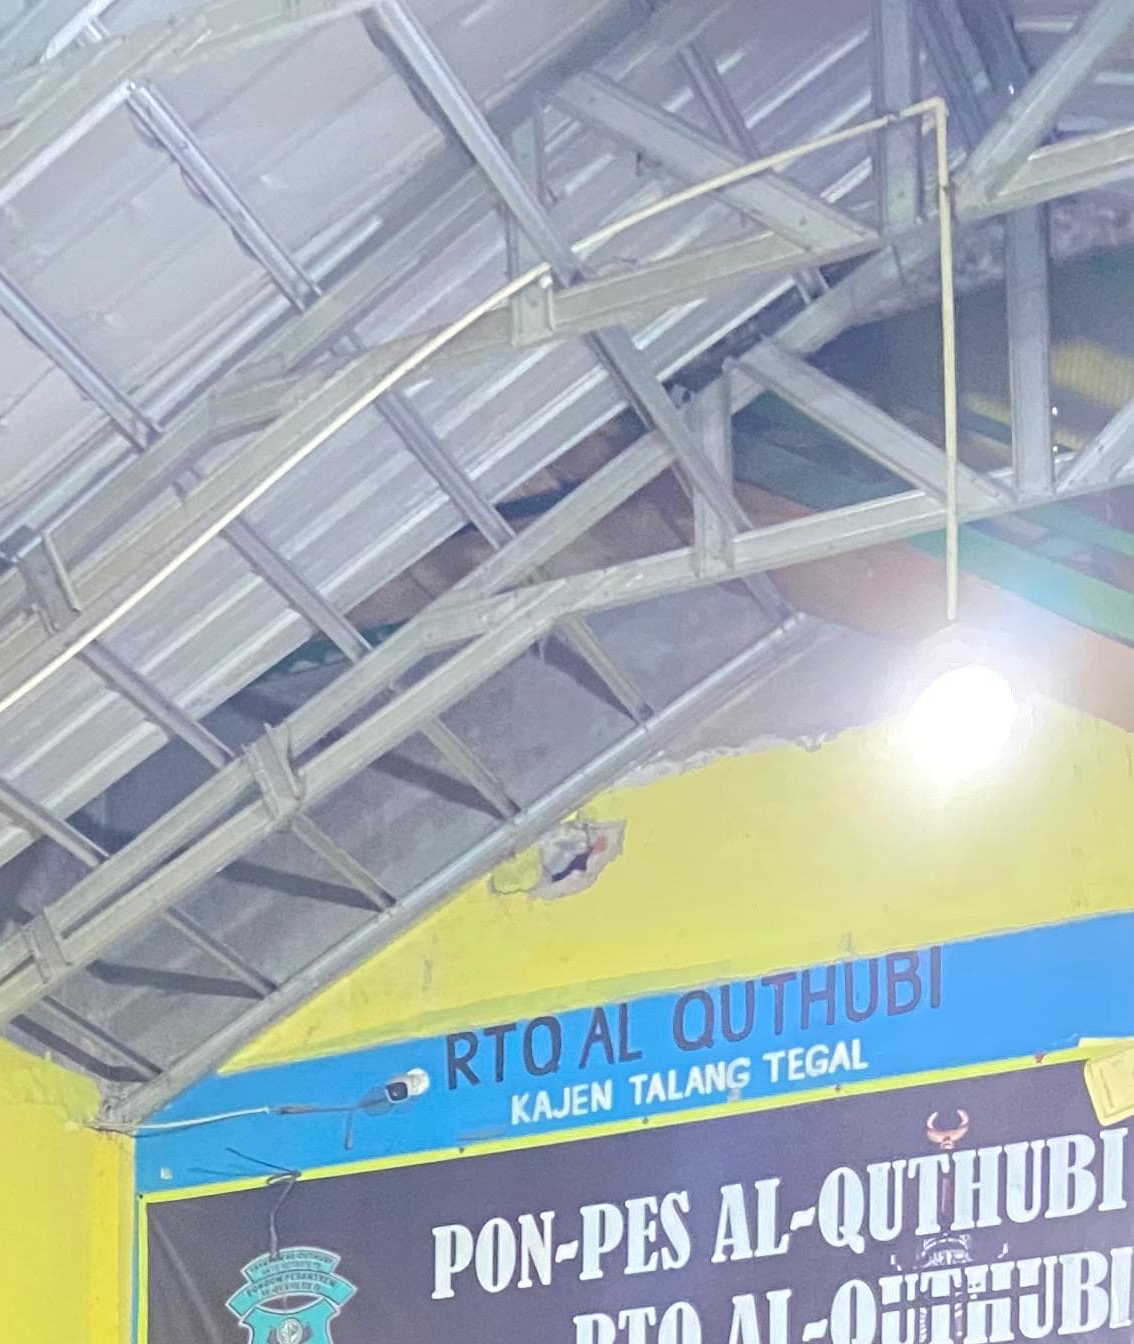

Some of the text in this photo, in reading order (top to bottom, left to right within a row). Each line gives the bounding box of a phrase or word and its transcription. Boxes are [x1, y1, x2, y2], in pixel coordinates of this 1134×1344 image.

[446, 946, 942, 1091] RTQ AL QUTHUBI
[511, 1038, 869, 1126] KAJEN TALANG TEGAL
[431, 1127, 1129, 1300] PON-PES AL-QUTHUBI
